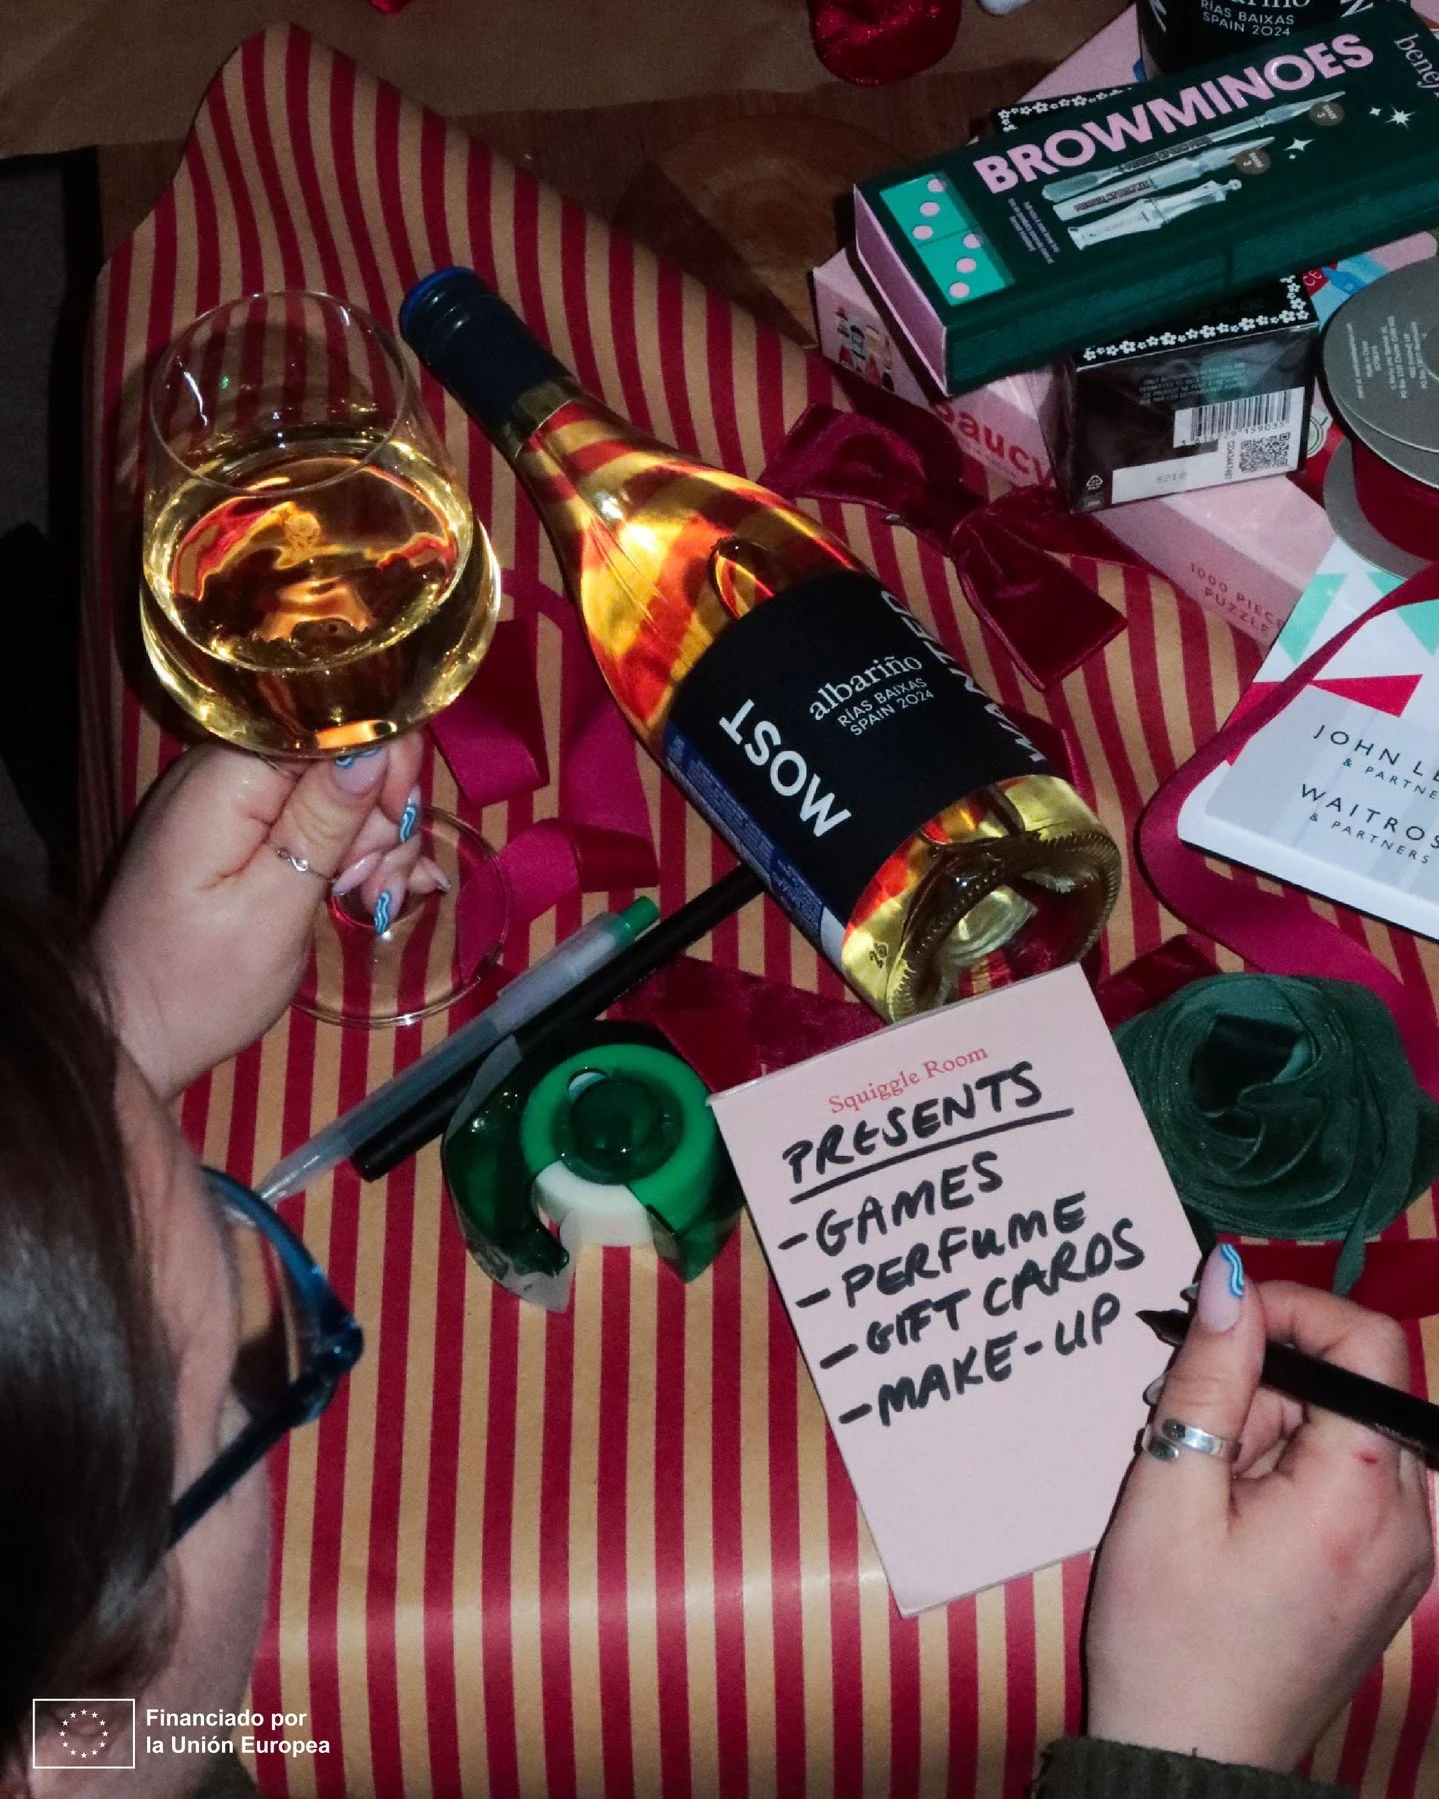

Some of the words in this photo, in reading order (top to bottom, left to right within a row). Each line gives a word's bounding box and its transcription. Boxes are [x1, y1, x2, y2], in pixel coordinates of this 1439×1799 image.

[1203, 11, 1246, 33] SPAIN
[1252, 24, 1291, 37] 2024
[1238, 11, 1295, 26] BAIXAS
[1394, 32, 1439, 97] benef
[973, 33, 1375, 195] BROWMINOES
[1190, 562, 1228, 593] 1000
[1205, 587, 1270, 634] PUZZLE
[808, 655, 922, 721] albariño
[837, 699, 875, 728] RÍAS
[876, 677, 928, 713] BAIXAS
[850, 704, 896, 736] SPAIN
[895, 688, 935, 711] 2024
[719, 699, 852, 837] MOST
[1313, 724, 1401, 766] JOHN
[1343, 757, 1352, 768] &
[1309, 812, 1318, 822] &
[1331, 820, 1430, 864] PARTNERS
[828, 1070, 921, 1114] Squiggle
[923, 1046, 989, 1079] Room
[782, 1060, 1043, 1184] PRESENTS
[982, 1217, 1145, 1317] CARDS
